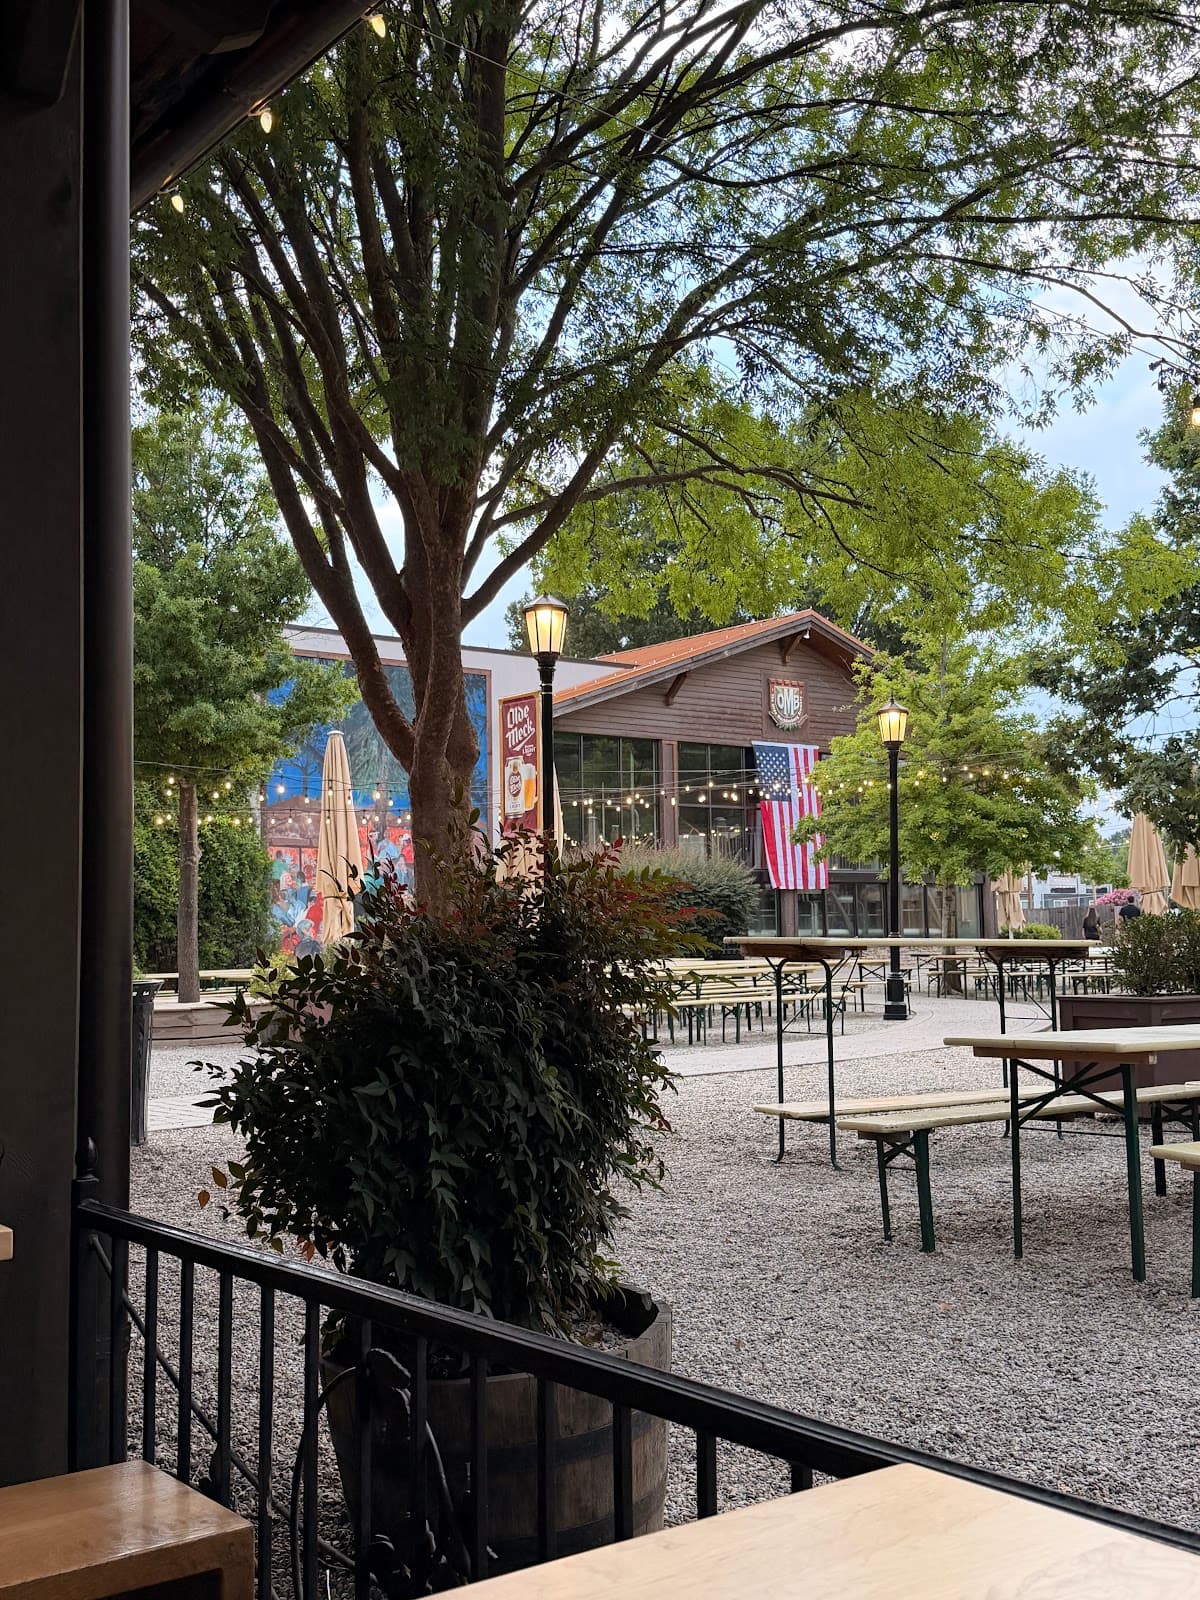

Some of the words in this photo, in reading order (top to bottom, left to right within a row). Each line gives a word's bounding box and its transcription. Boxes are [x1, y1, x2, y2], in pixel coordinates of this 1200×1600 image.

[777, 688, 799, 715] OMB
[507, 705, 529, 729] Olde
[506, 718, 535, 751] Meck
